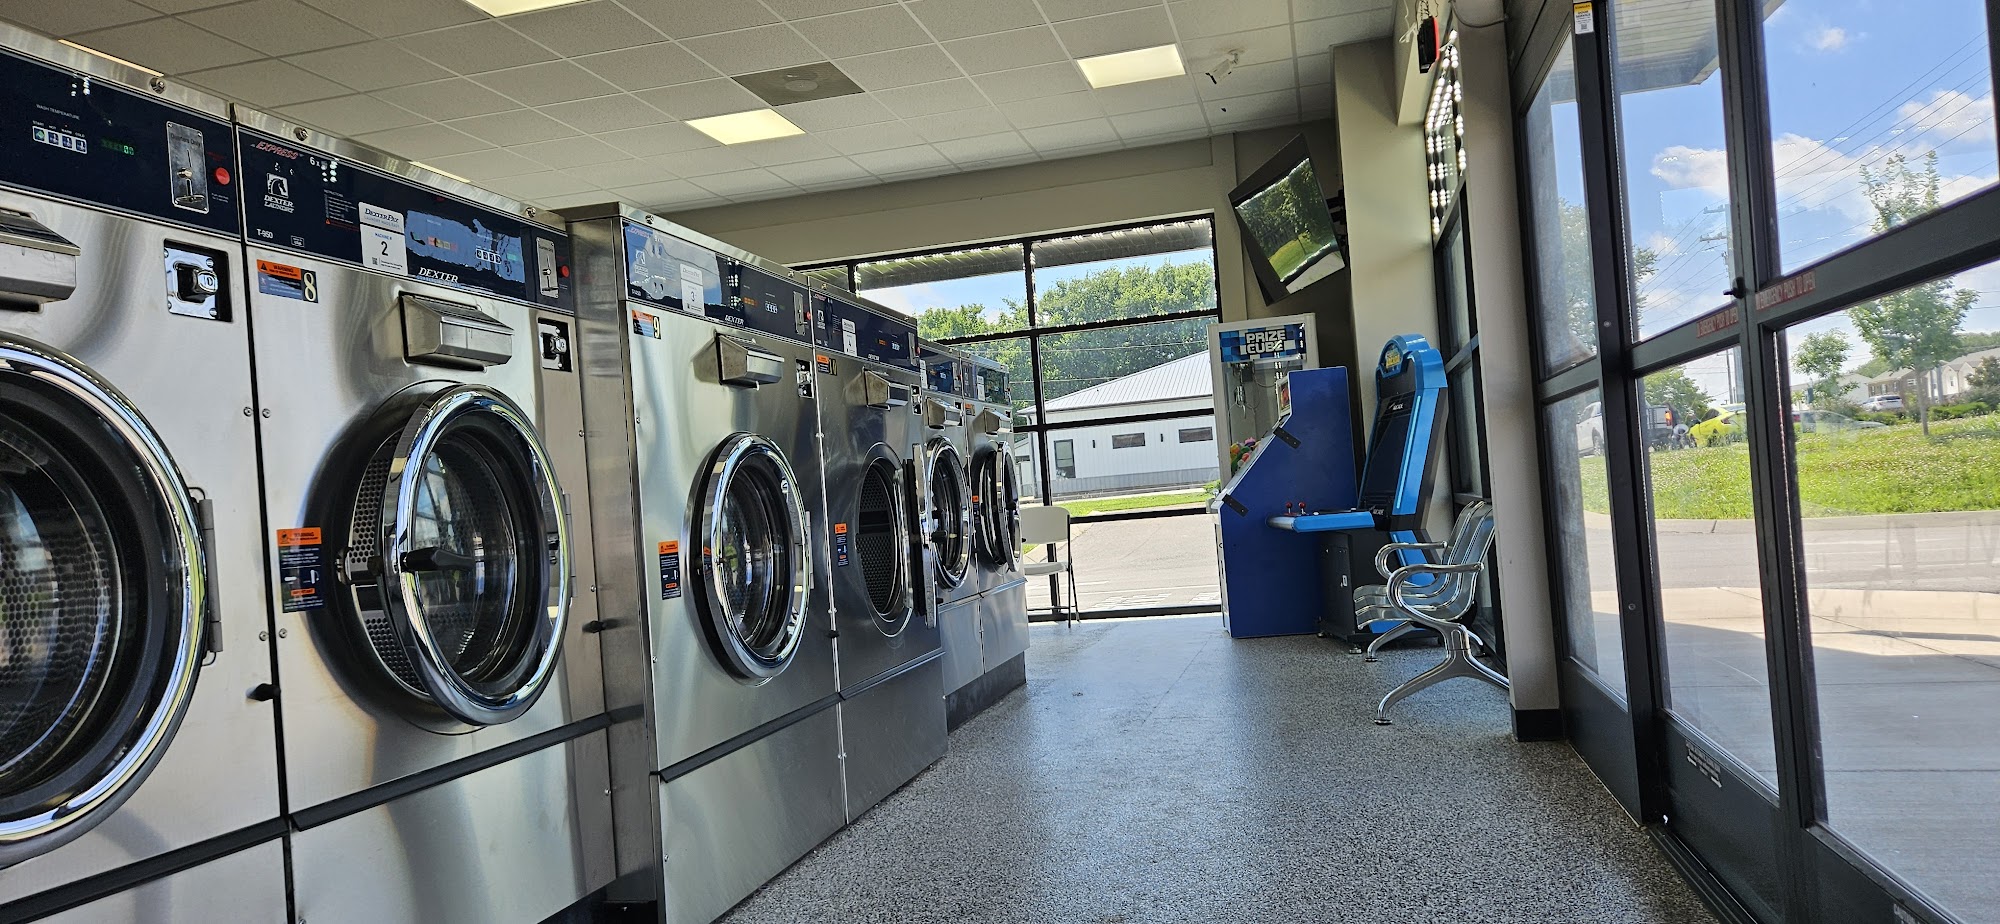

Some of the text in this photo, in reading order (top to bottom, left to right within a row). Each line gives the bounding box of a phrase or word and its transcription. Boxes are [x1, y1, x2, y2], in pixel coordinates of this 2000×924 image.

[256, 141, 299, 160] EXPRESS
[263, 194, 294, 207] DEXTER
[263, 201, 295, 214] LAUNDRY
[381, 241, 389, 257] 2
[418, 267, 459, 283] DEXTER
[303, 272, 317, 302] 8
[653, 316, 661, 338] 9
[725, 314, 745, 325] DEXTER
[1245, 330, 1286, 343] PRIZE
[1247, 340, 1283, 354] CUBE
